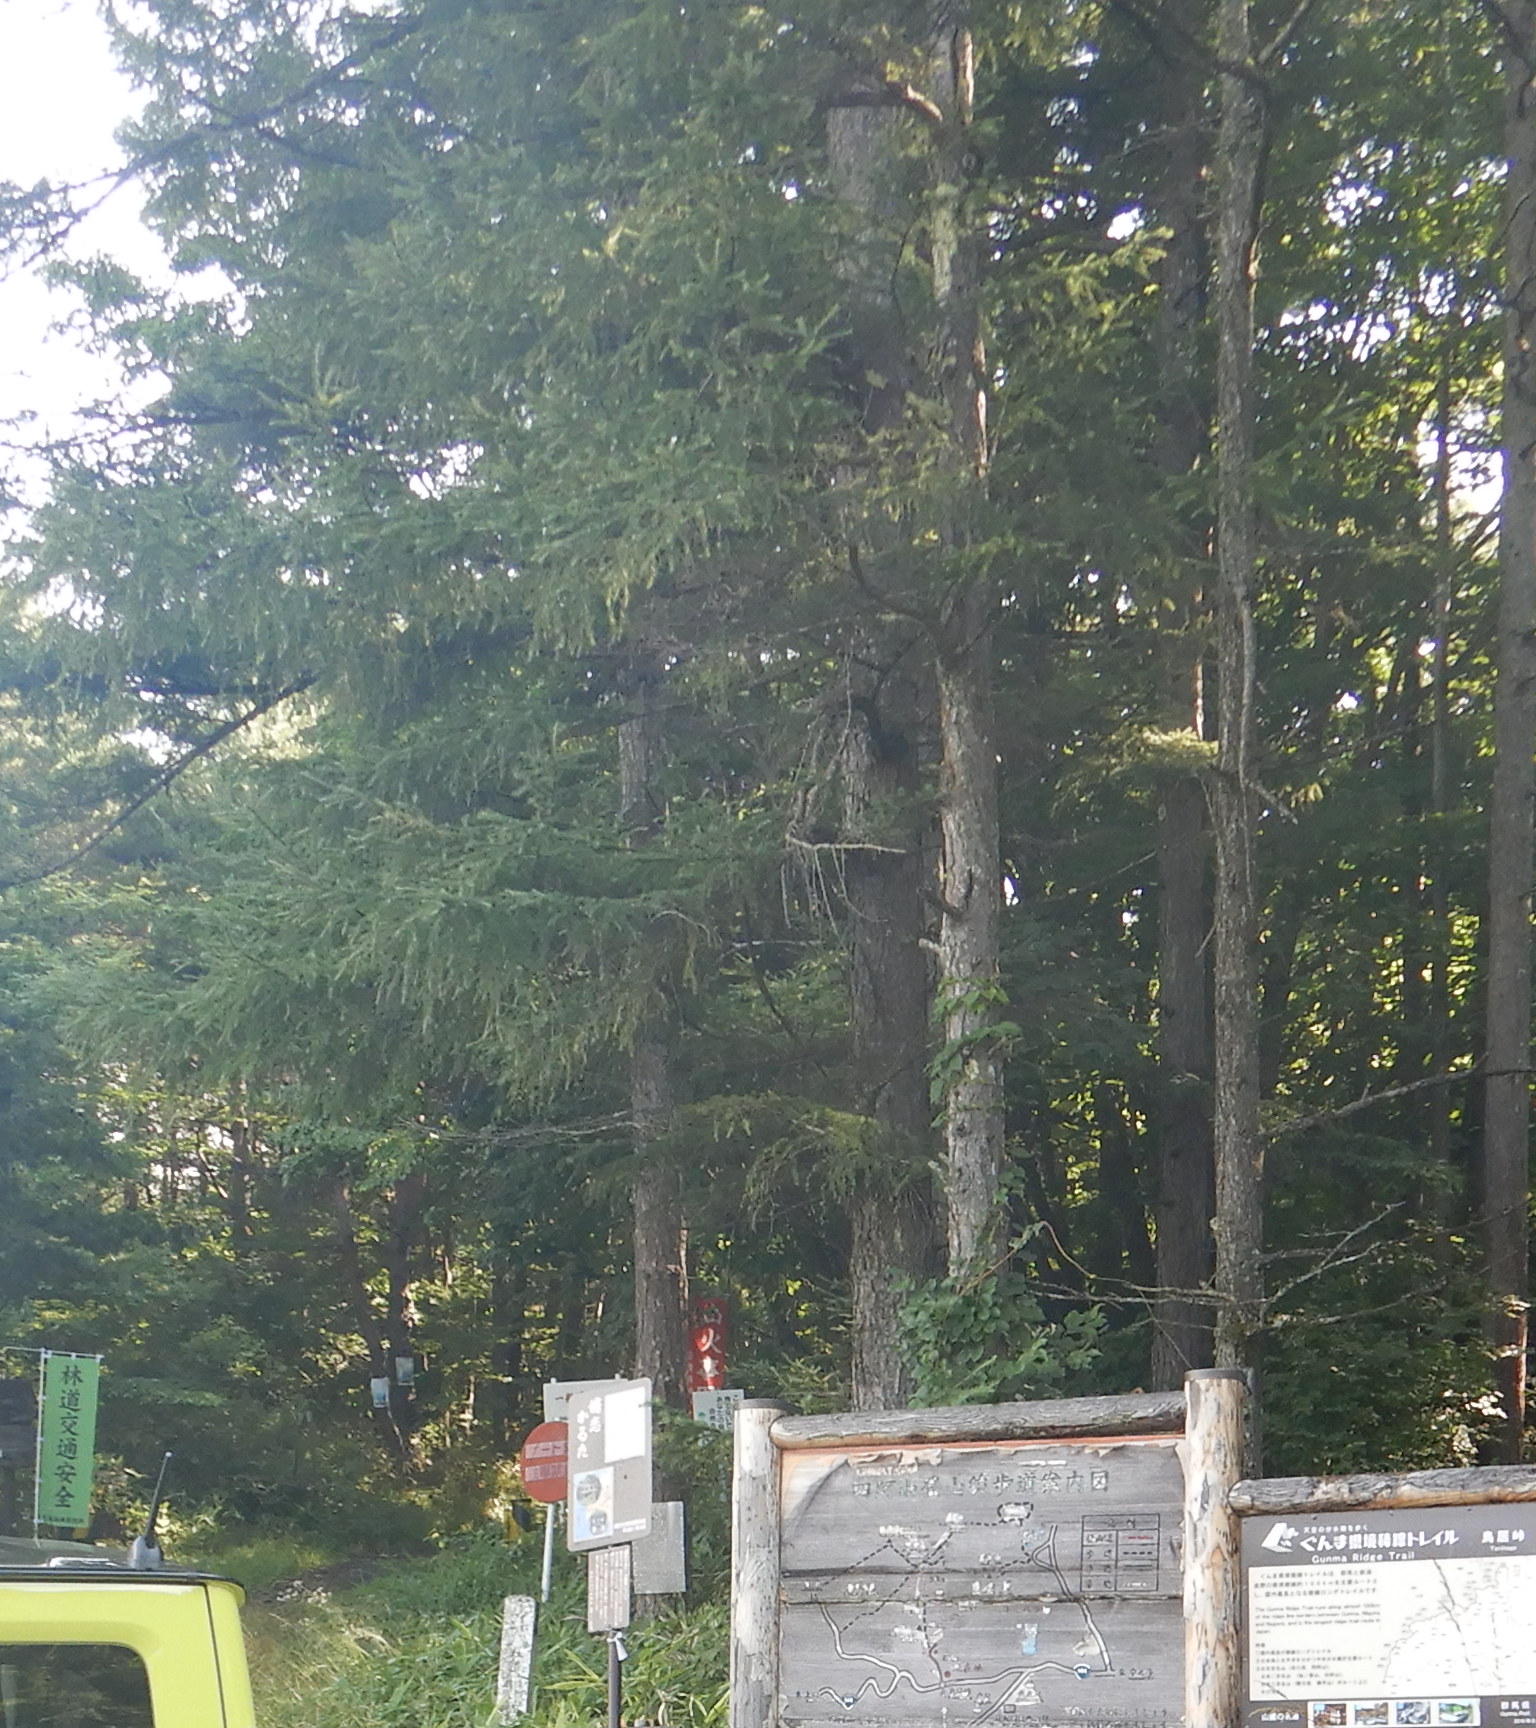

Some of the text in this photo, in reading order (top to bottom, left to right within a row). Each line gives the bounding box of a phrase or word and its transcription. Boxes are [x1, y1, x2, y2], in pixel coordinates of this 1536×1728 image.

[54, 1364, 84, 1508] 林道交通安全
[1311, 1551, 1415, 1564] Gunma Ridge Trail
